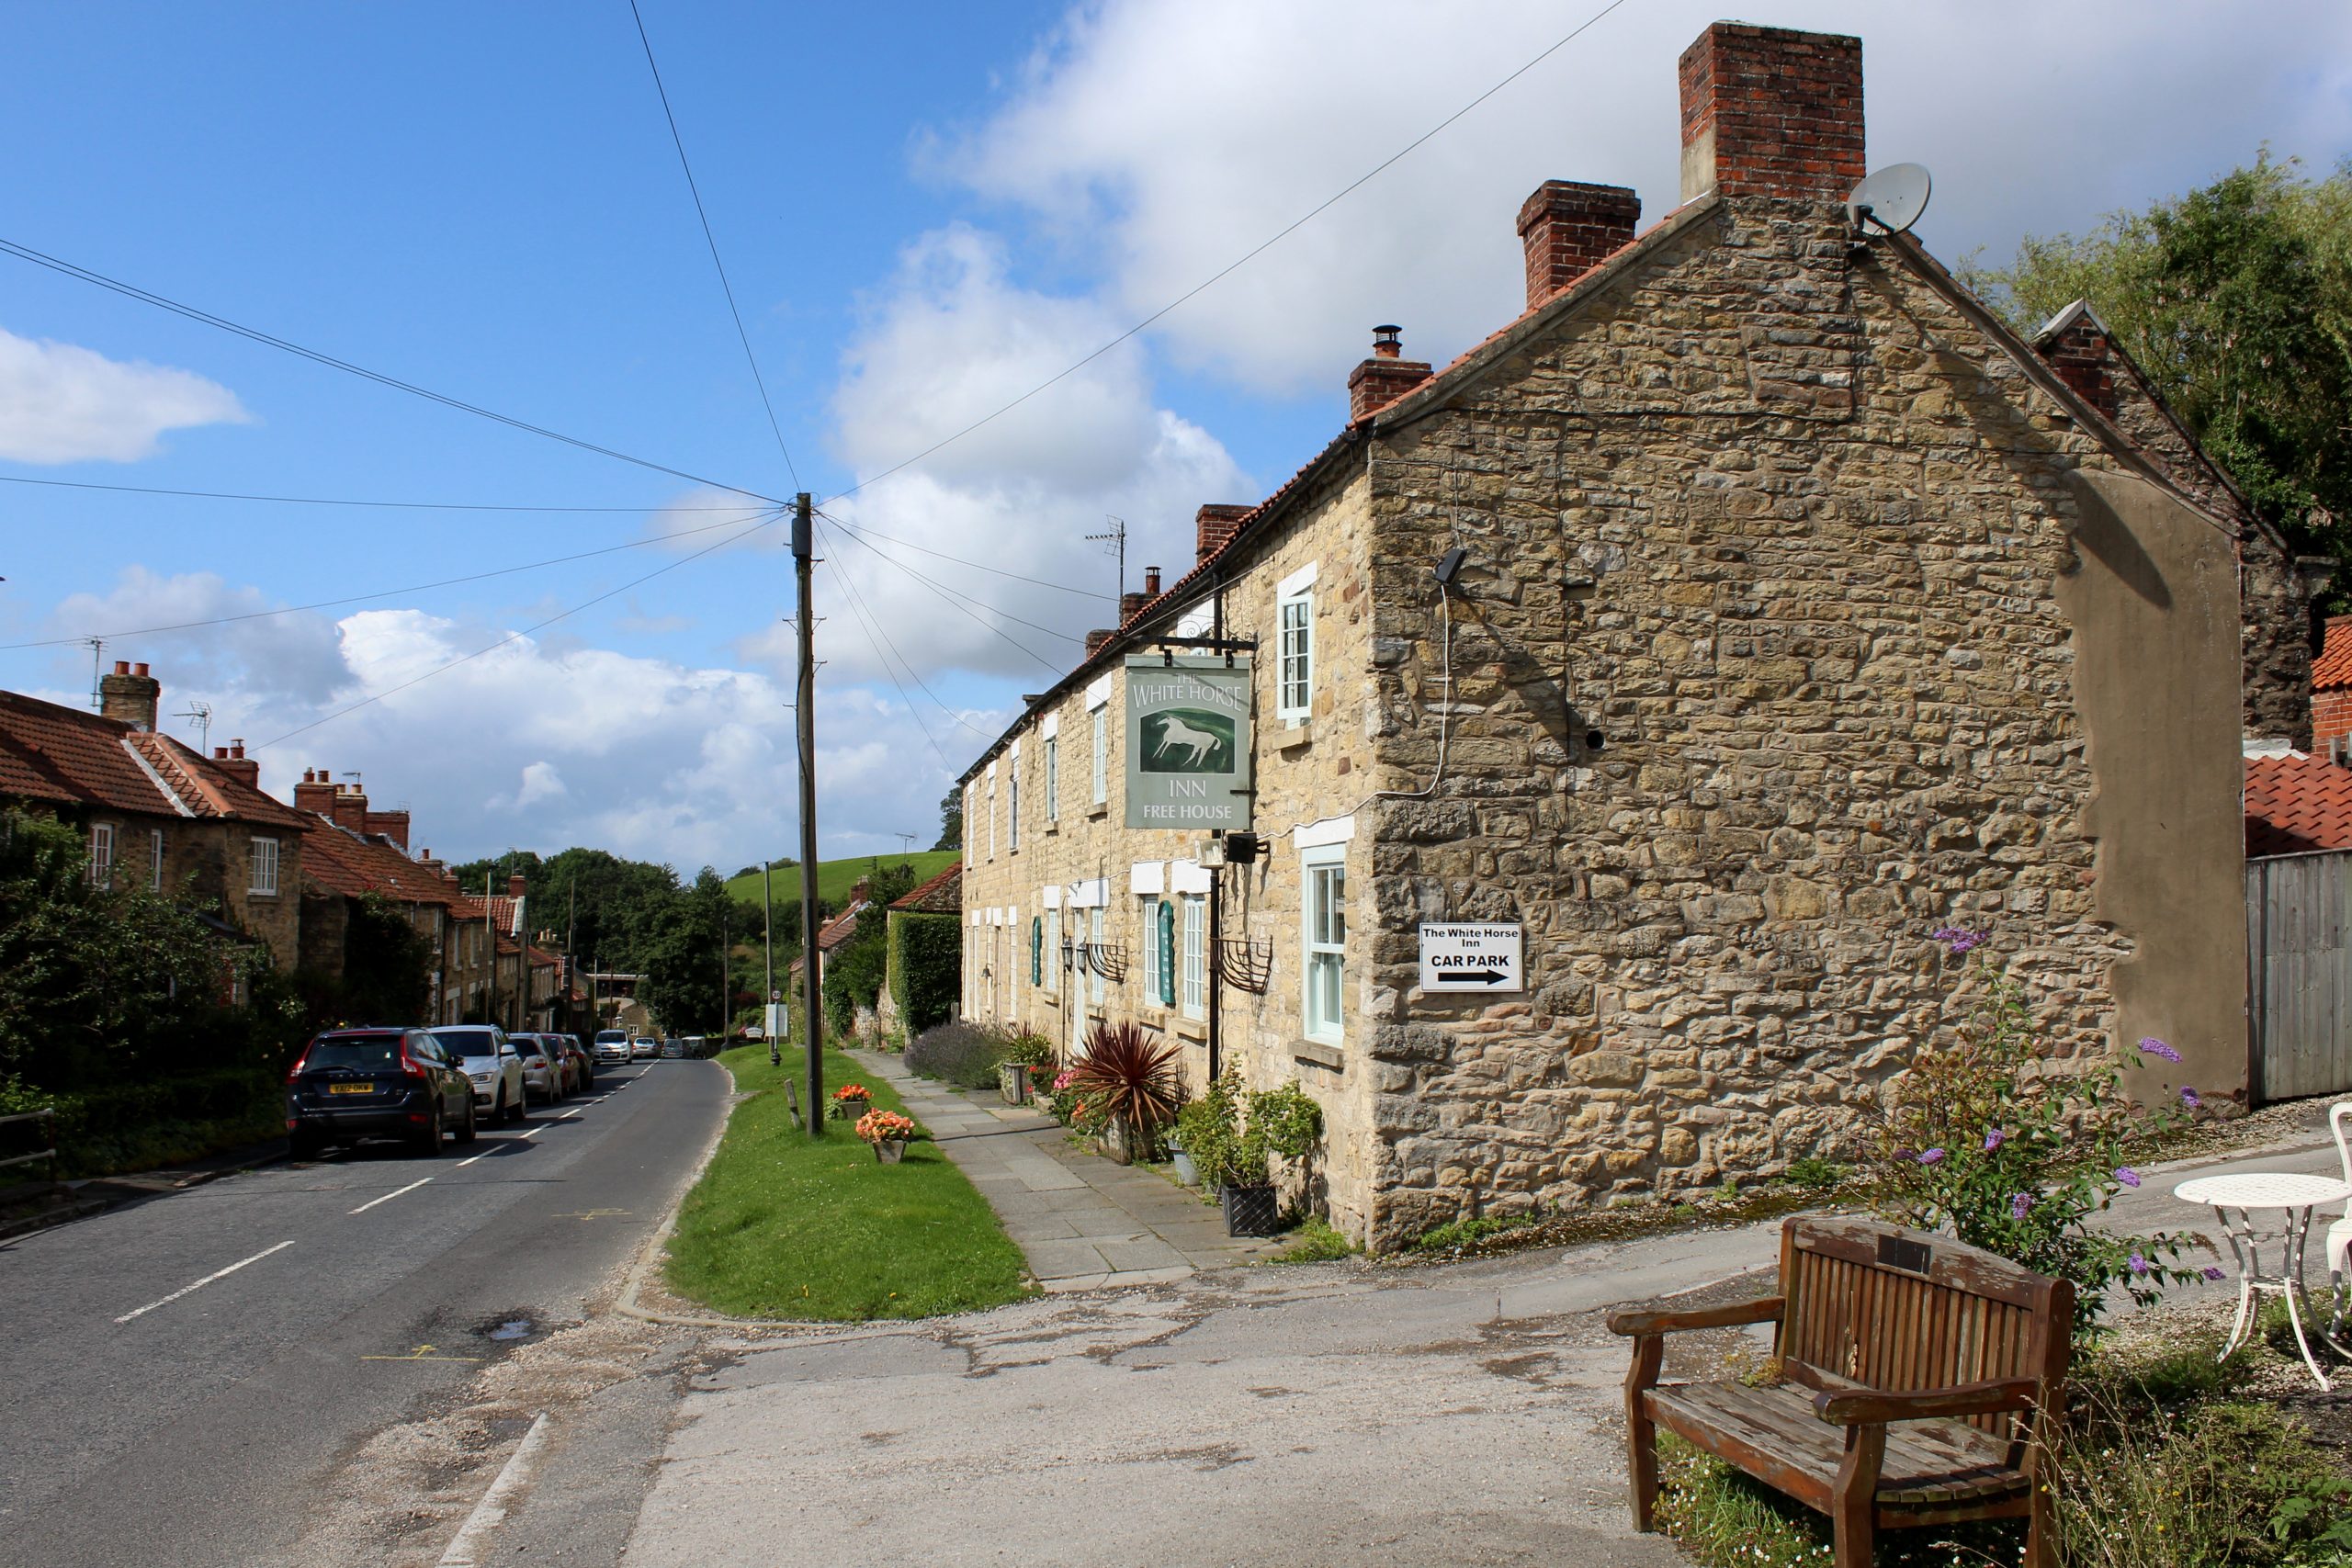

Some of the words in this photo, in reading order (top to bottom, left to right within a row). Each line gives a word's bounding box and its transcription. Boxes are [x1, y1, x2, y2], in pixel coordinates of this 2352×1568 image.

[1176, 672, 1199, 684] THE
[1133, 684, 1184, 708] WHITE
[1189, 685, 1242, 712] HORSE
[1170, 779, 1206, 797] INN
[1143, 805, 1176, 818] FREE
[1180, 805, 1232, 819] HOUSE
[1423, 929, 1445, 938] The
[1447, 929, 1482, 938] White
[1484, 929, 1519, 938] Horse
[1462, 939, 1480, 947] Inn
[1431, 955, 1464, 966] CAR
[1466, 955, 1510, 966] PARK
